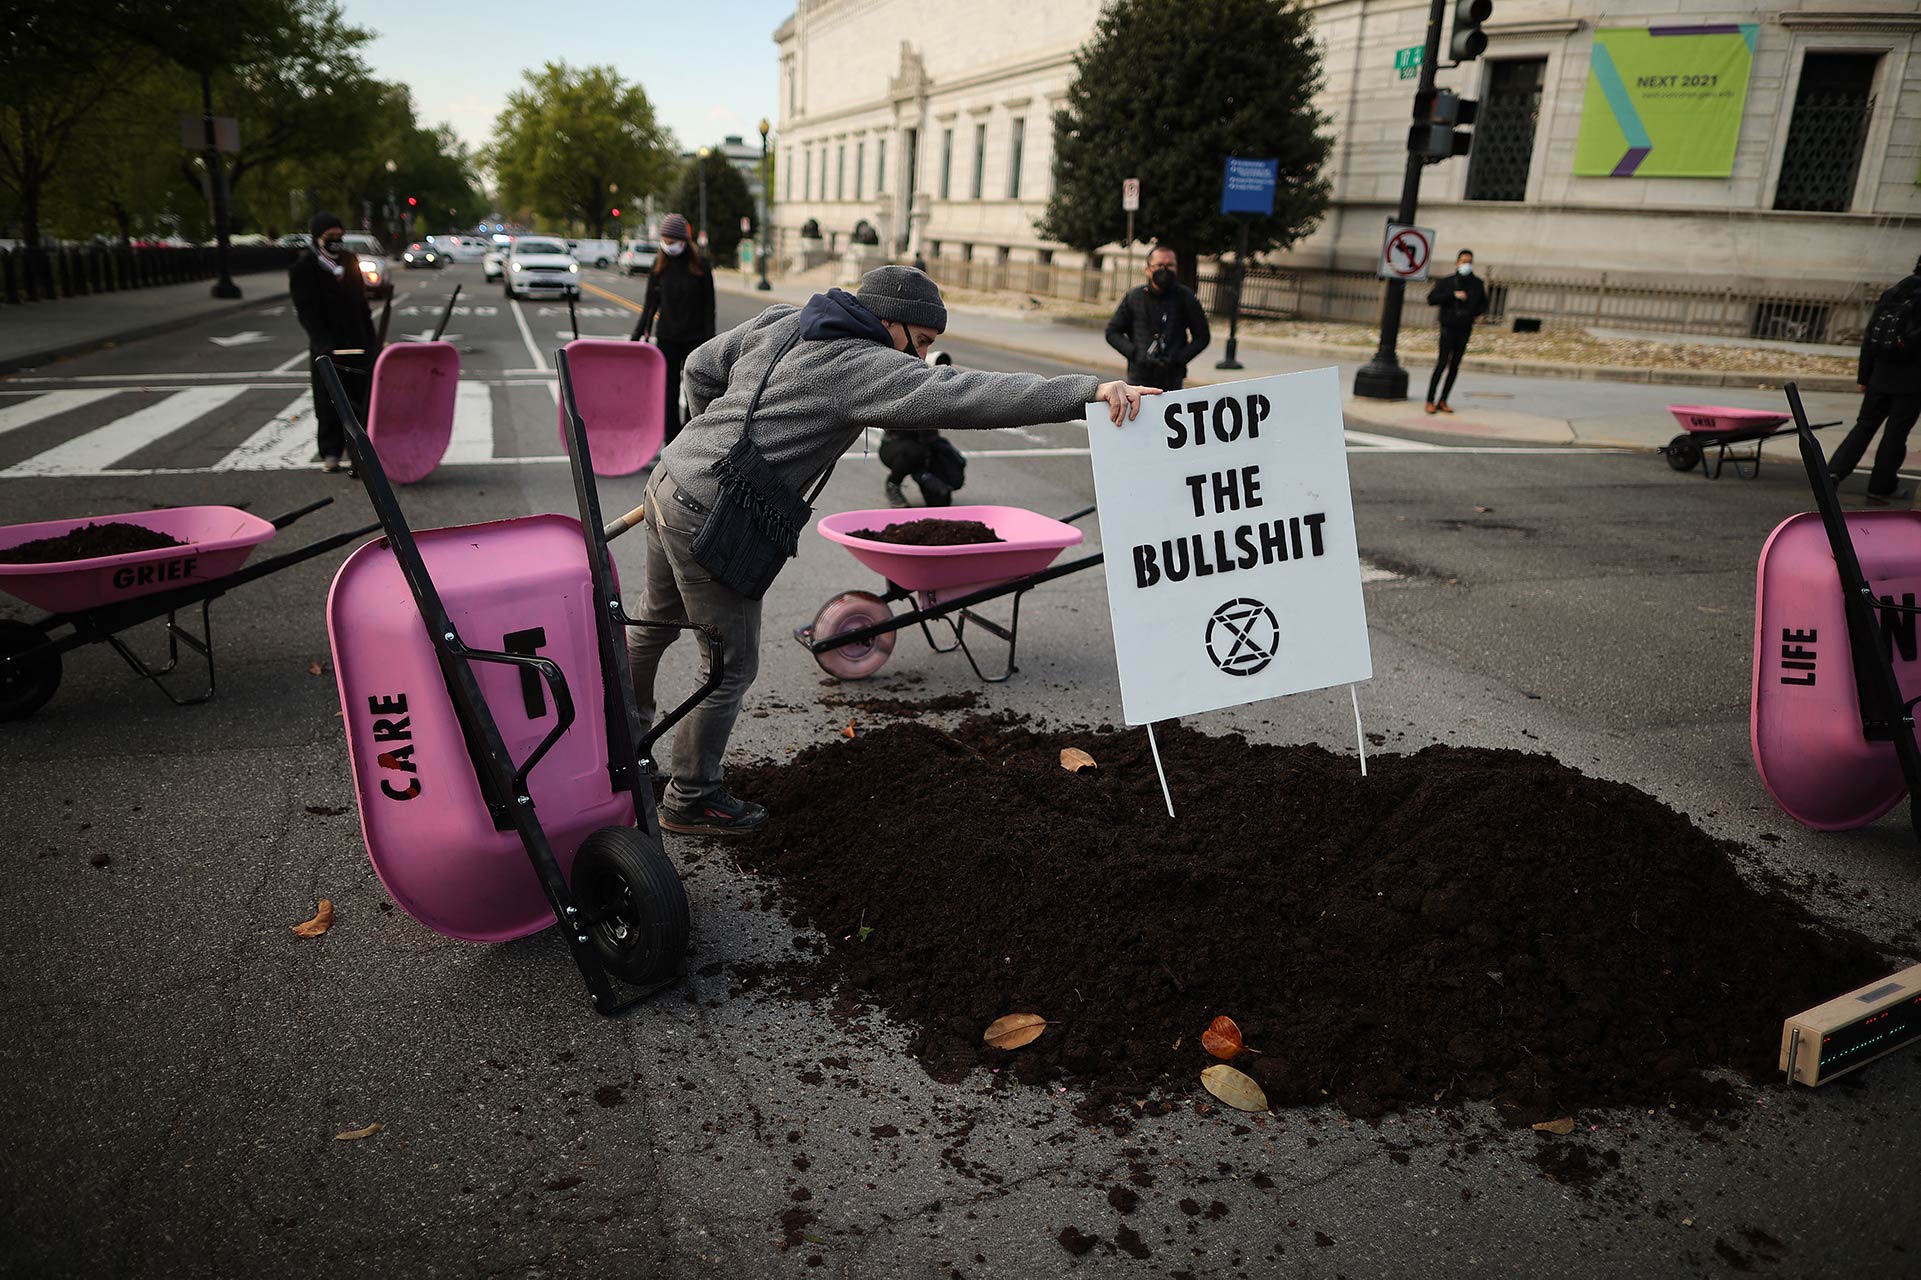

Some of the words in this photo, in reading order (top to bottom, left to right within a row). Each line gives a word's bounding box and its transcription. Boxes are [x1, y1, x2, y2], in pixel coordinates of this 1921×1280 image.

[1637, 75, 1678, 88] NEXT
[1682, 74, 1718, 87] 2021
[1163, 394, 1271, 450] STOP
[1185, 465, 1263, 518] THE
[113, 557, 198, 590] GRIEF
[1132, 513, 1326, 588] BULLSHIT
[1781, 628, 1818, 687] LIFE
[367, 693, 421, 801] CARE
